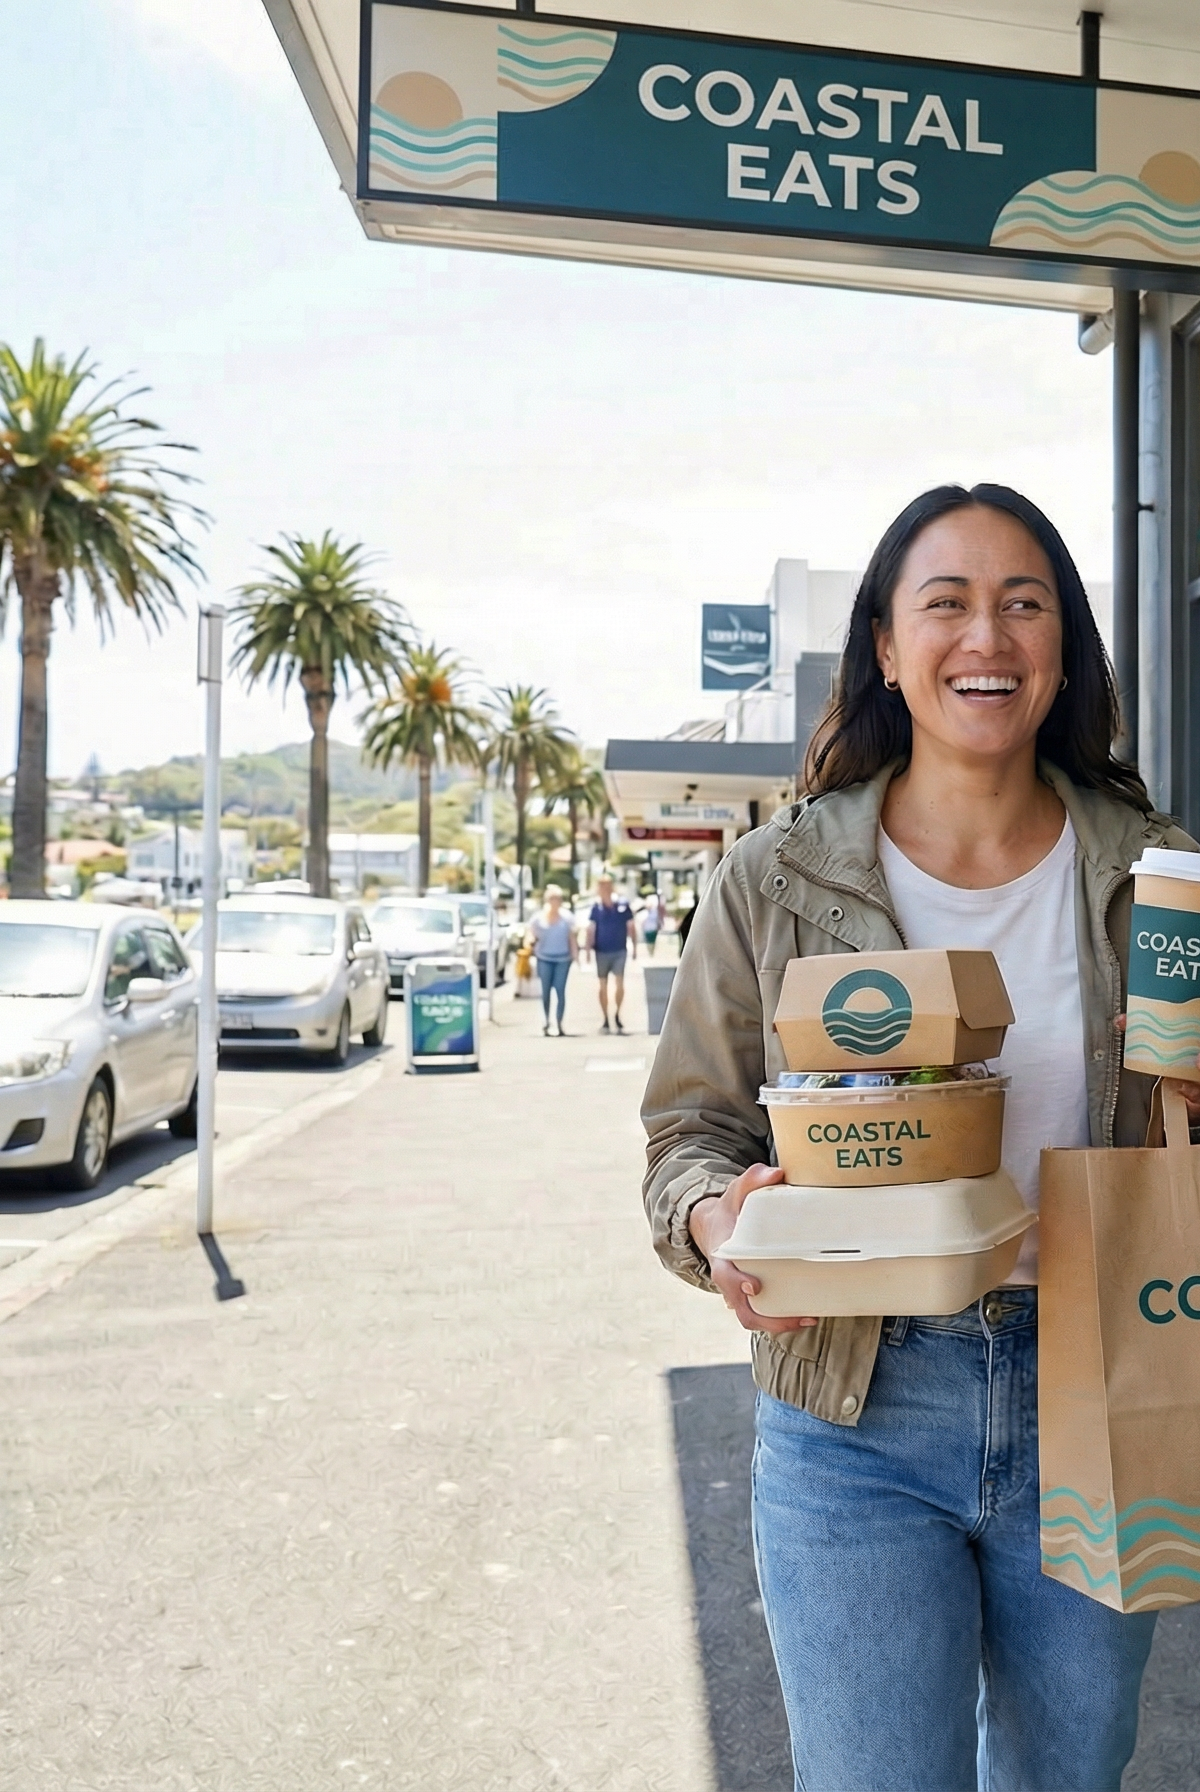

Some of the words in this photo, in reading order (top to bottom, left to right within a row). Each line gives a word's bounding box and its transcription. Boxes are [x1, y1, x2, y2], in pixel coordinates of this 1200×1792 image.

[638, 63, 1003, 155] COASTAL
[726, 143, 920, 215] EATS
[807, 1119, 931, 1144] COASTAL
[836, 1146, 903, 1169] EATS
